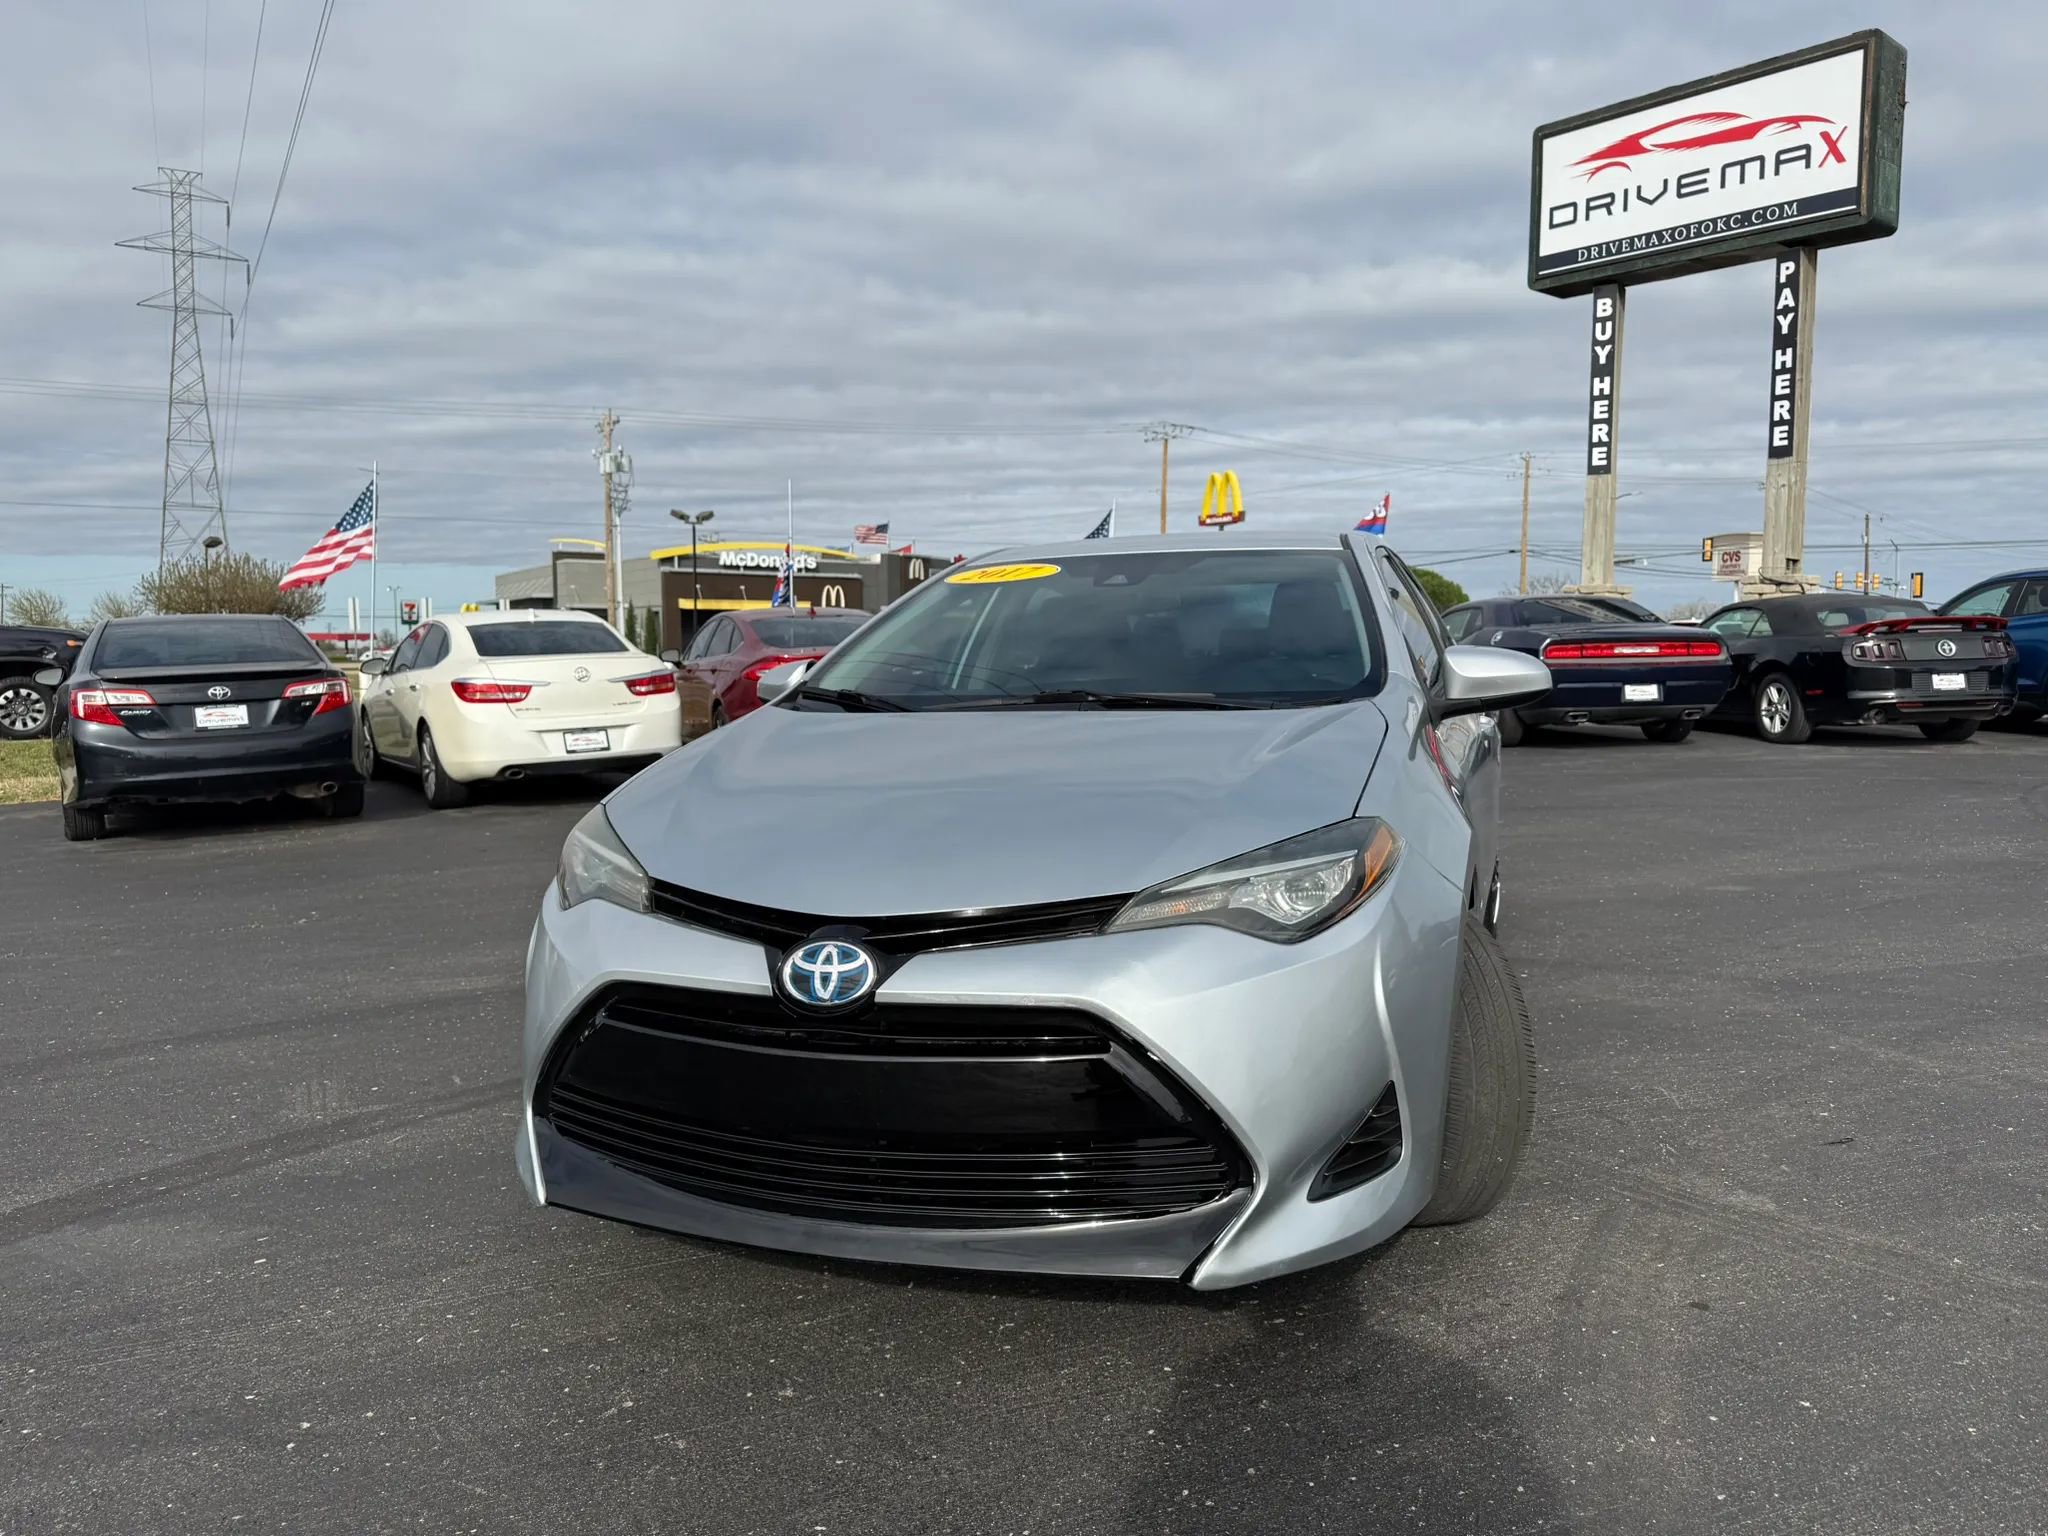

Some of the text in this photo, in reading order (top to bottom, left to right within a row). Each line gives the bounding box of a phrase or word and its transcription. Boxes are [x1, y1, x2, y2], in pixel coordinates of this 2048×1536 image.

[1548, 125, 1848, 230] DRIVEMAX
[1576, 201, 1799, 262] DRIVEMAXOFOKC.COM
[1591, 297, 1614, 467] BUY HERE
[1772, 260, 1796, 448] PAY HERE
[719, 551, 817, 570] McDond's
[1721, 549, 1741, 563] CVS
